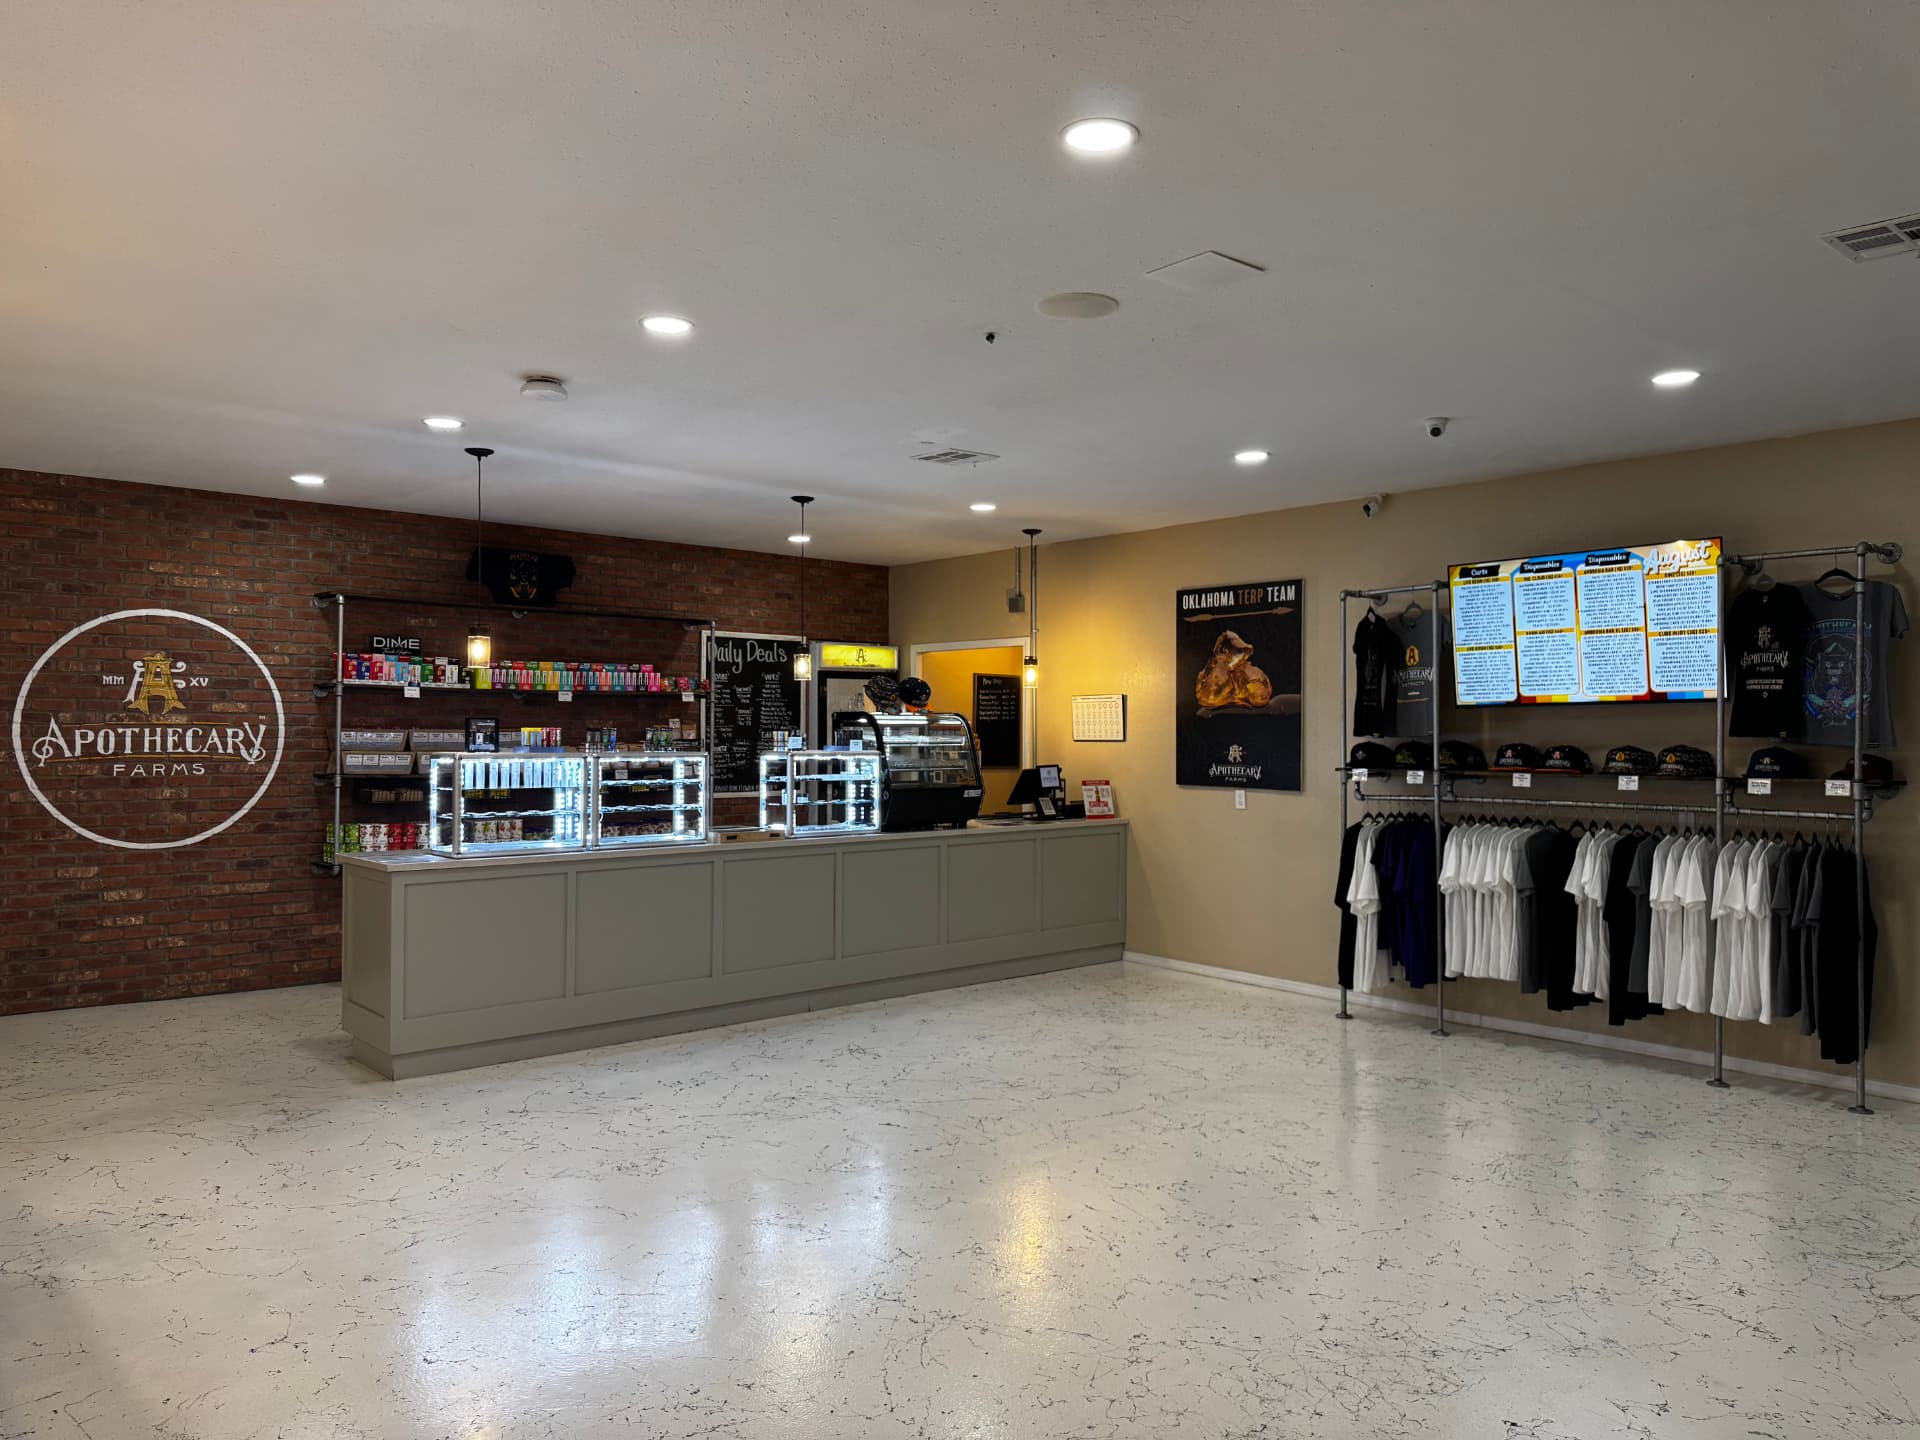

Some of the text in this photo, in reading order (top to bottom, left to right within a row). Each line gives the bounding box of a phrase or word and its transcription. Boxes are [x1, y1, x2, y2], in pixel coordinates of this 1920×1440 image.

[1587, 553, 1627, 565] Disposables
[1643, 540, 1712, 575] August
[1470, 568, 1488, 577] Carts
[1523, 560, 1560, 572] Disposables
[1182, 585, 1295, 609] OKLAHOMA TERP TEAM
[373, 635, 420, 649] DIME
[707, 640, 788, 673] Daily Deals
[103, 674, 124, 685] MM
[190, 676, 208, 687] XV
[31, 717, 266, 767] APOTHECARY
[113, 763, 205, 777] FARMS
[1209, 762, 1262, 780] APOTHECARY
